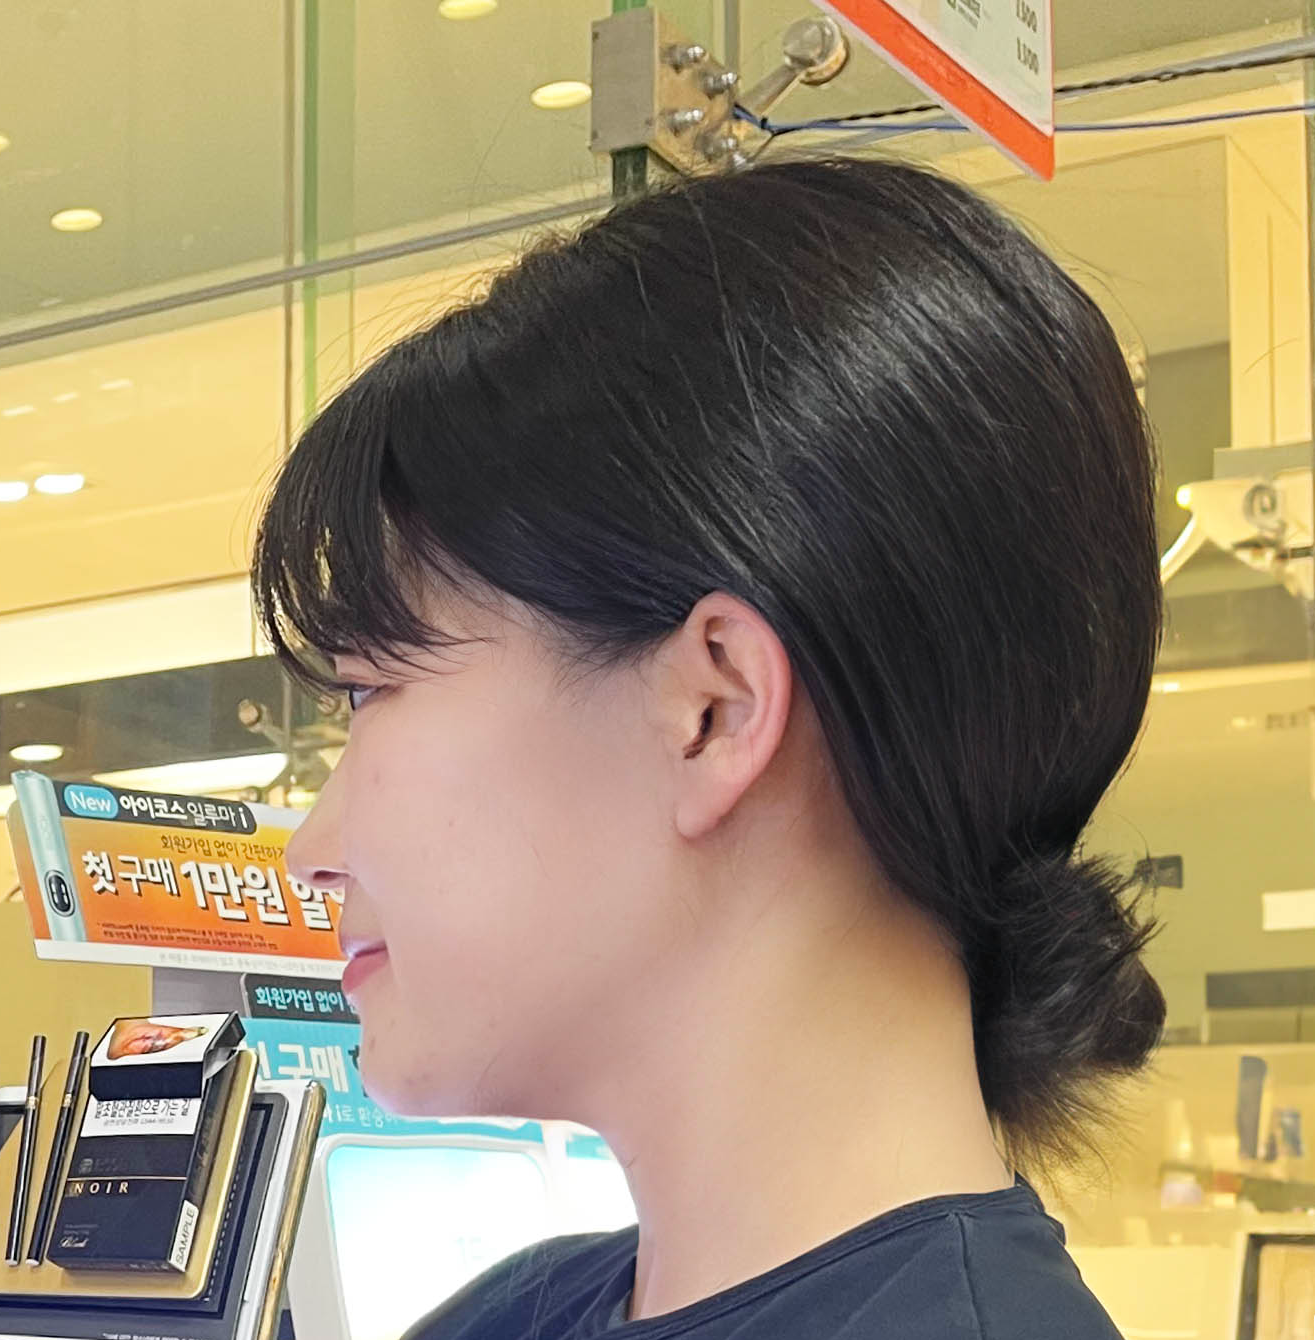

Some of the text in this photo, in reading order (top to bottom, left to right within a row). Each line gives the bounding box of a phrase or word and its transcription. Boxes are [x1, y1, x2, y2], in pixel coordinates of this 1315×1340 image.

[69, 791, 112, 813] New
[119, 794, 188, 821] 아이코스
[186, 803, 237, 827] 일루마
[161, 834, 210, 857] 회원가입
[82, 851, 117, 894] 첫
[118, 855, 179, 896] 구매
[180, 861, 291, 924] 1만원
[256, 987, 314, 1012] 회원가입
[74, 1181, 129, 1194] NOIR
[175, 1207, 195, 1265] SAMPLE
